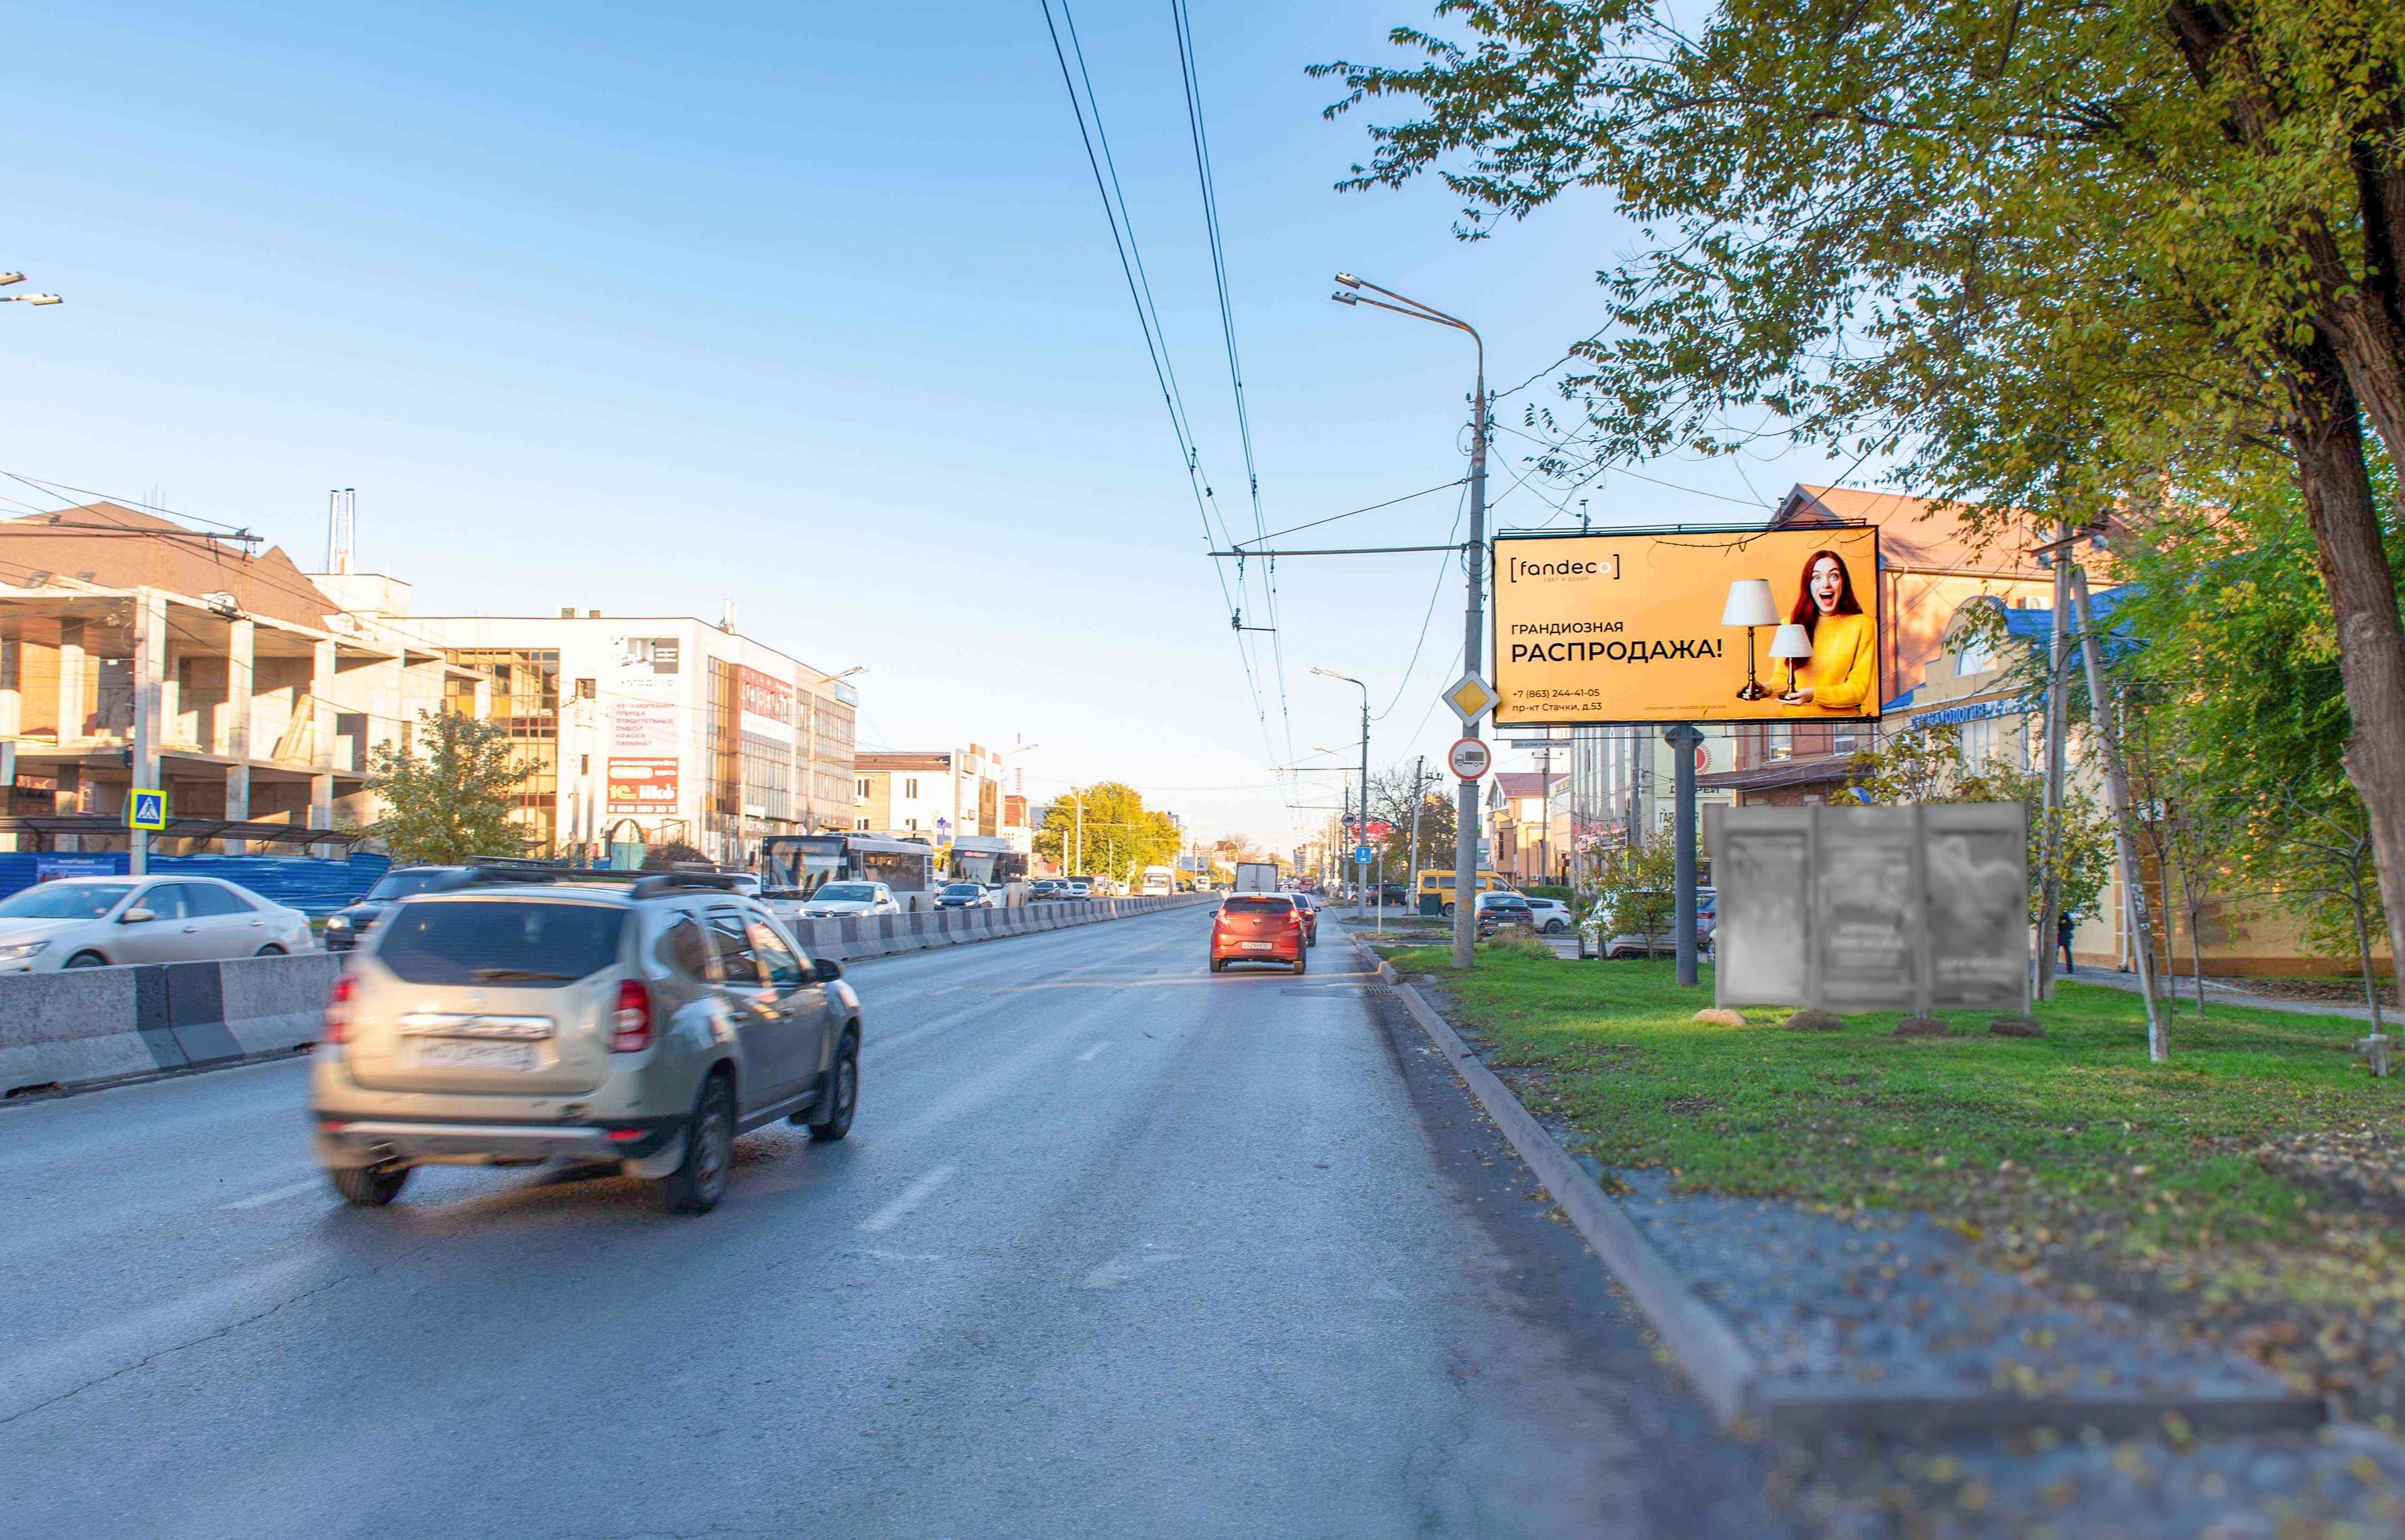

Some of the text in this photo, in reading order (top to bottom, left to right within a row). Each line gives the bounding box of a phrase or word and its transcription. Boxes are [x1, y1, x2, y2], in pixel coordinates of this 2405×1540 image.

[1511, 621, 1624, 636] ГРАНДИОЗНАЯ
[1512, 639, 1722, 664] РАСПРОДАЖА!
[1526, 690, 1549, 699] (863)
[1552, 689, 1600, 697] 244-41-05
[1513, 702, 1602, 713] пр-кт Стачки, д.53
